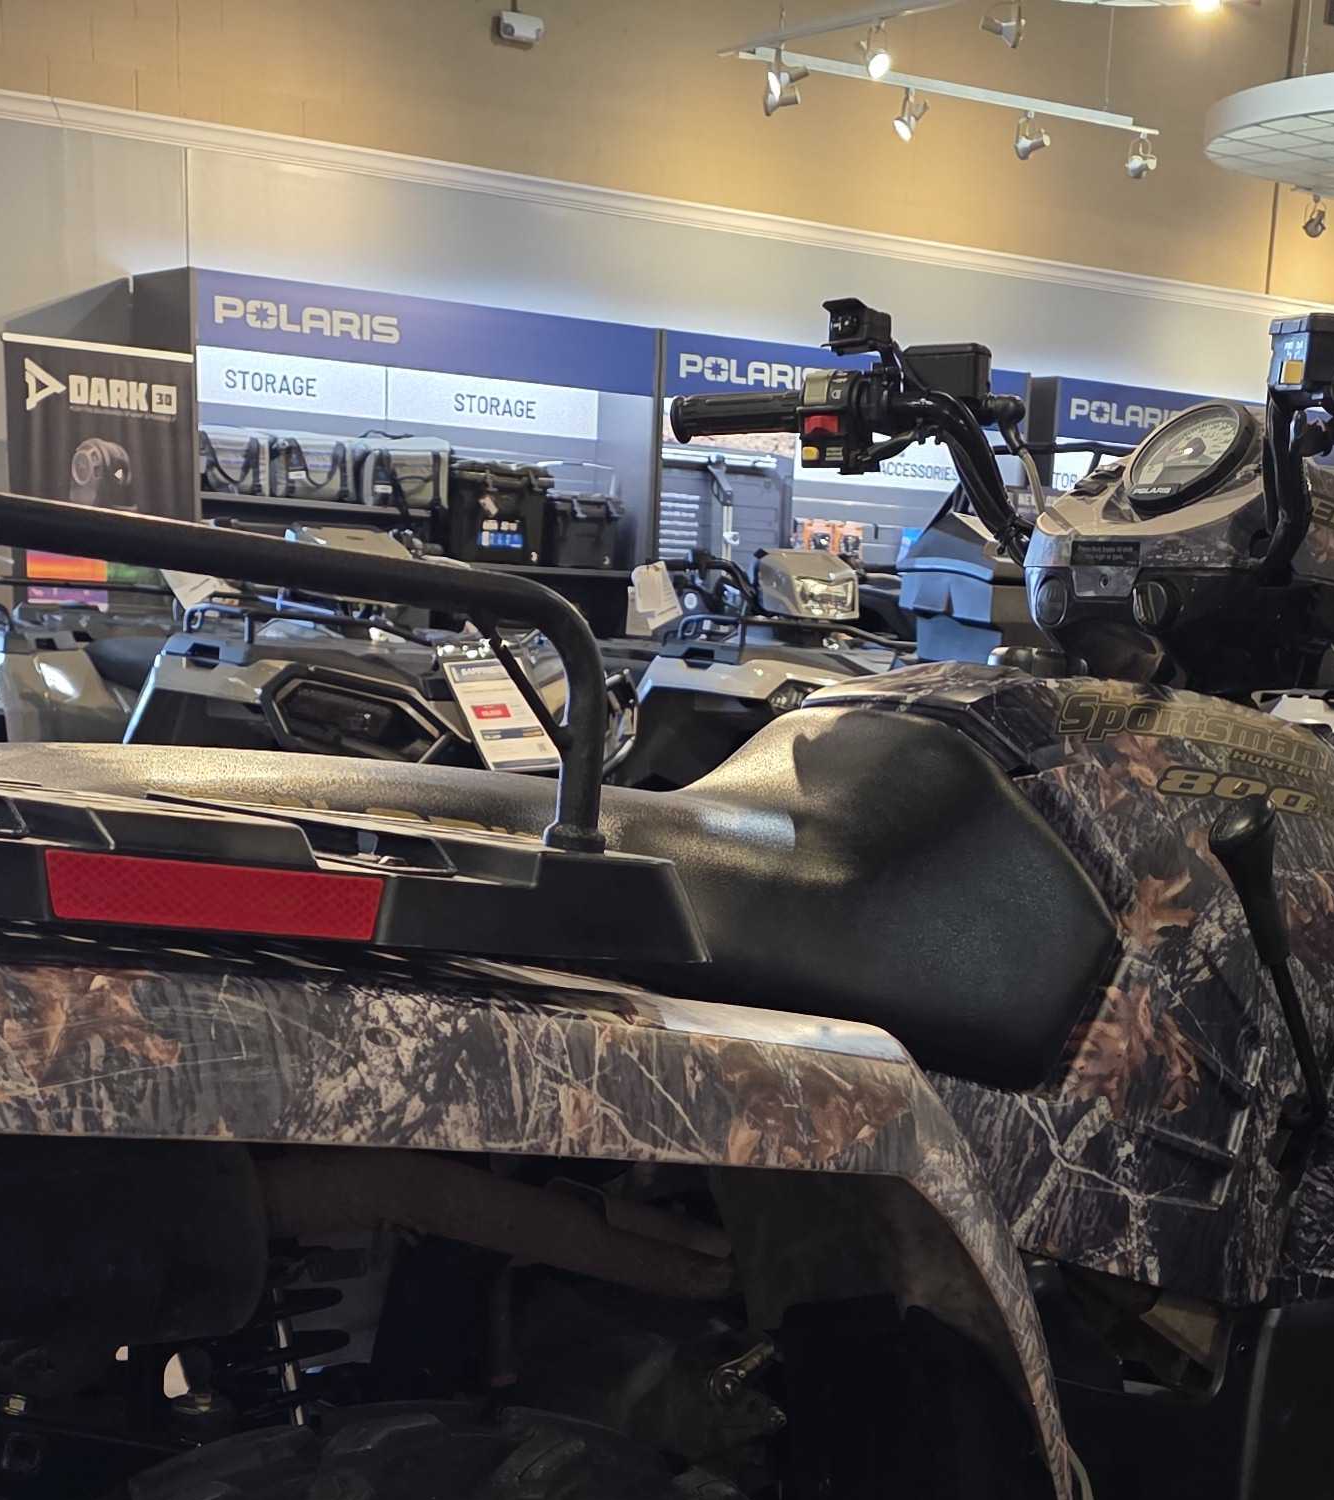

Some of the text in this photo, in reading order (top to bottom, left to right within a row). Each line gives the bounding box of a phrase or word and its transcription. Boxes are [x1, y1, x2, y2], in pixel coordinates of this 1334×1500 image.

[214, 295, 400, 344] POLARIS
[225, 369, 317, 397] STORAGE
[679, 353, 817, 391] POLARI
[454, 393, 536, 420] STORAGE
[1069, 398, 1179, 429] POLARI
[1055, 692, 1329, 772] Sportsman
[1231, 750, 1314, 778] HUNTER
[1155, 765, 1319, 816] 800
